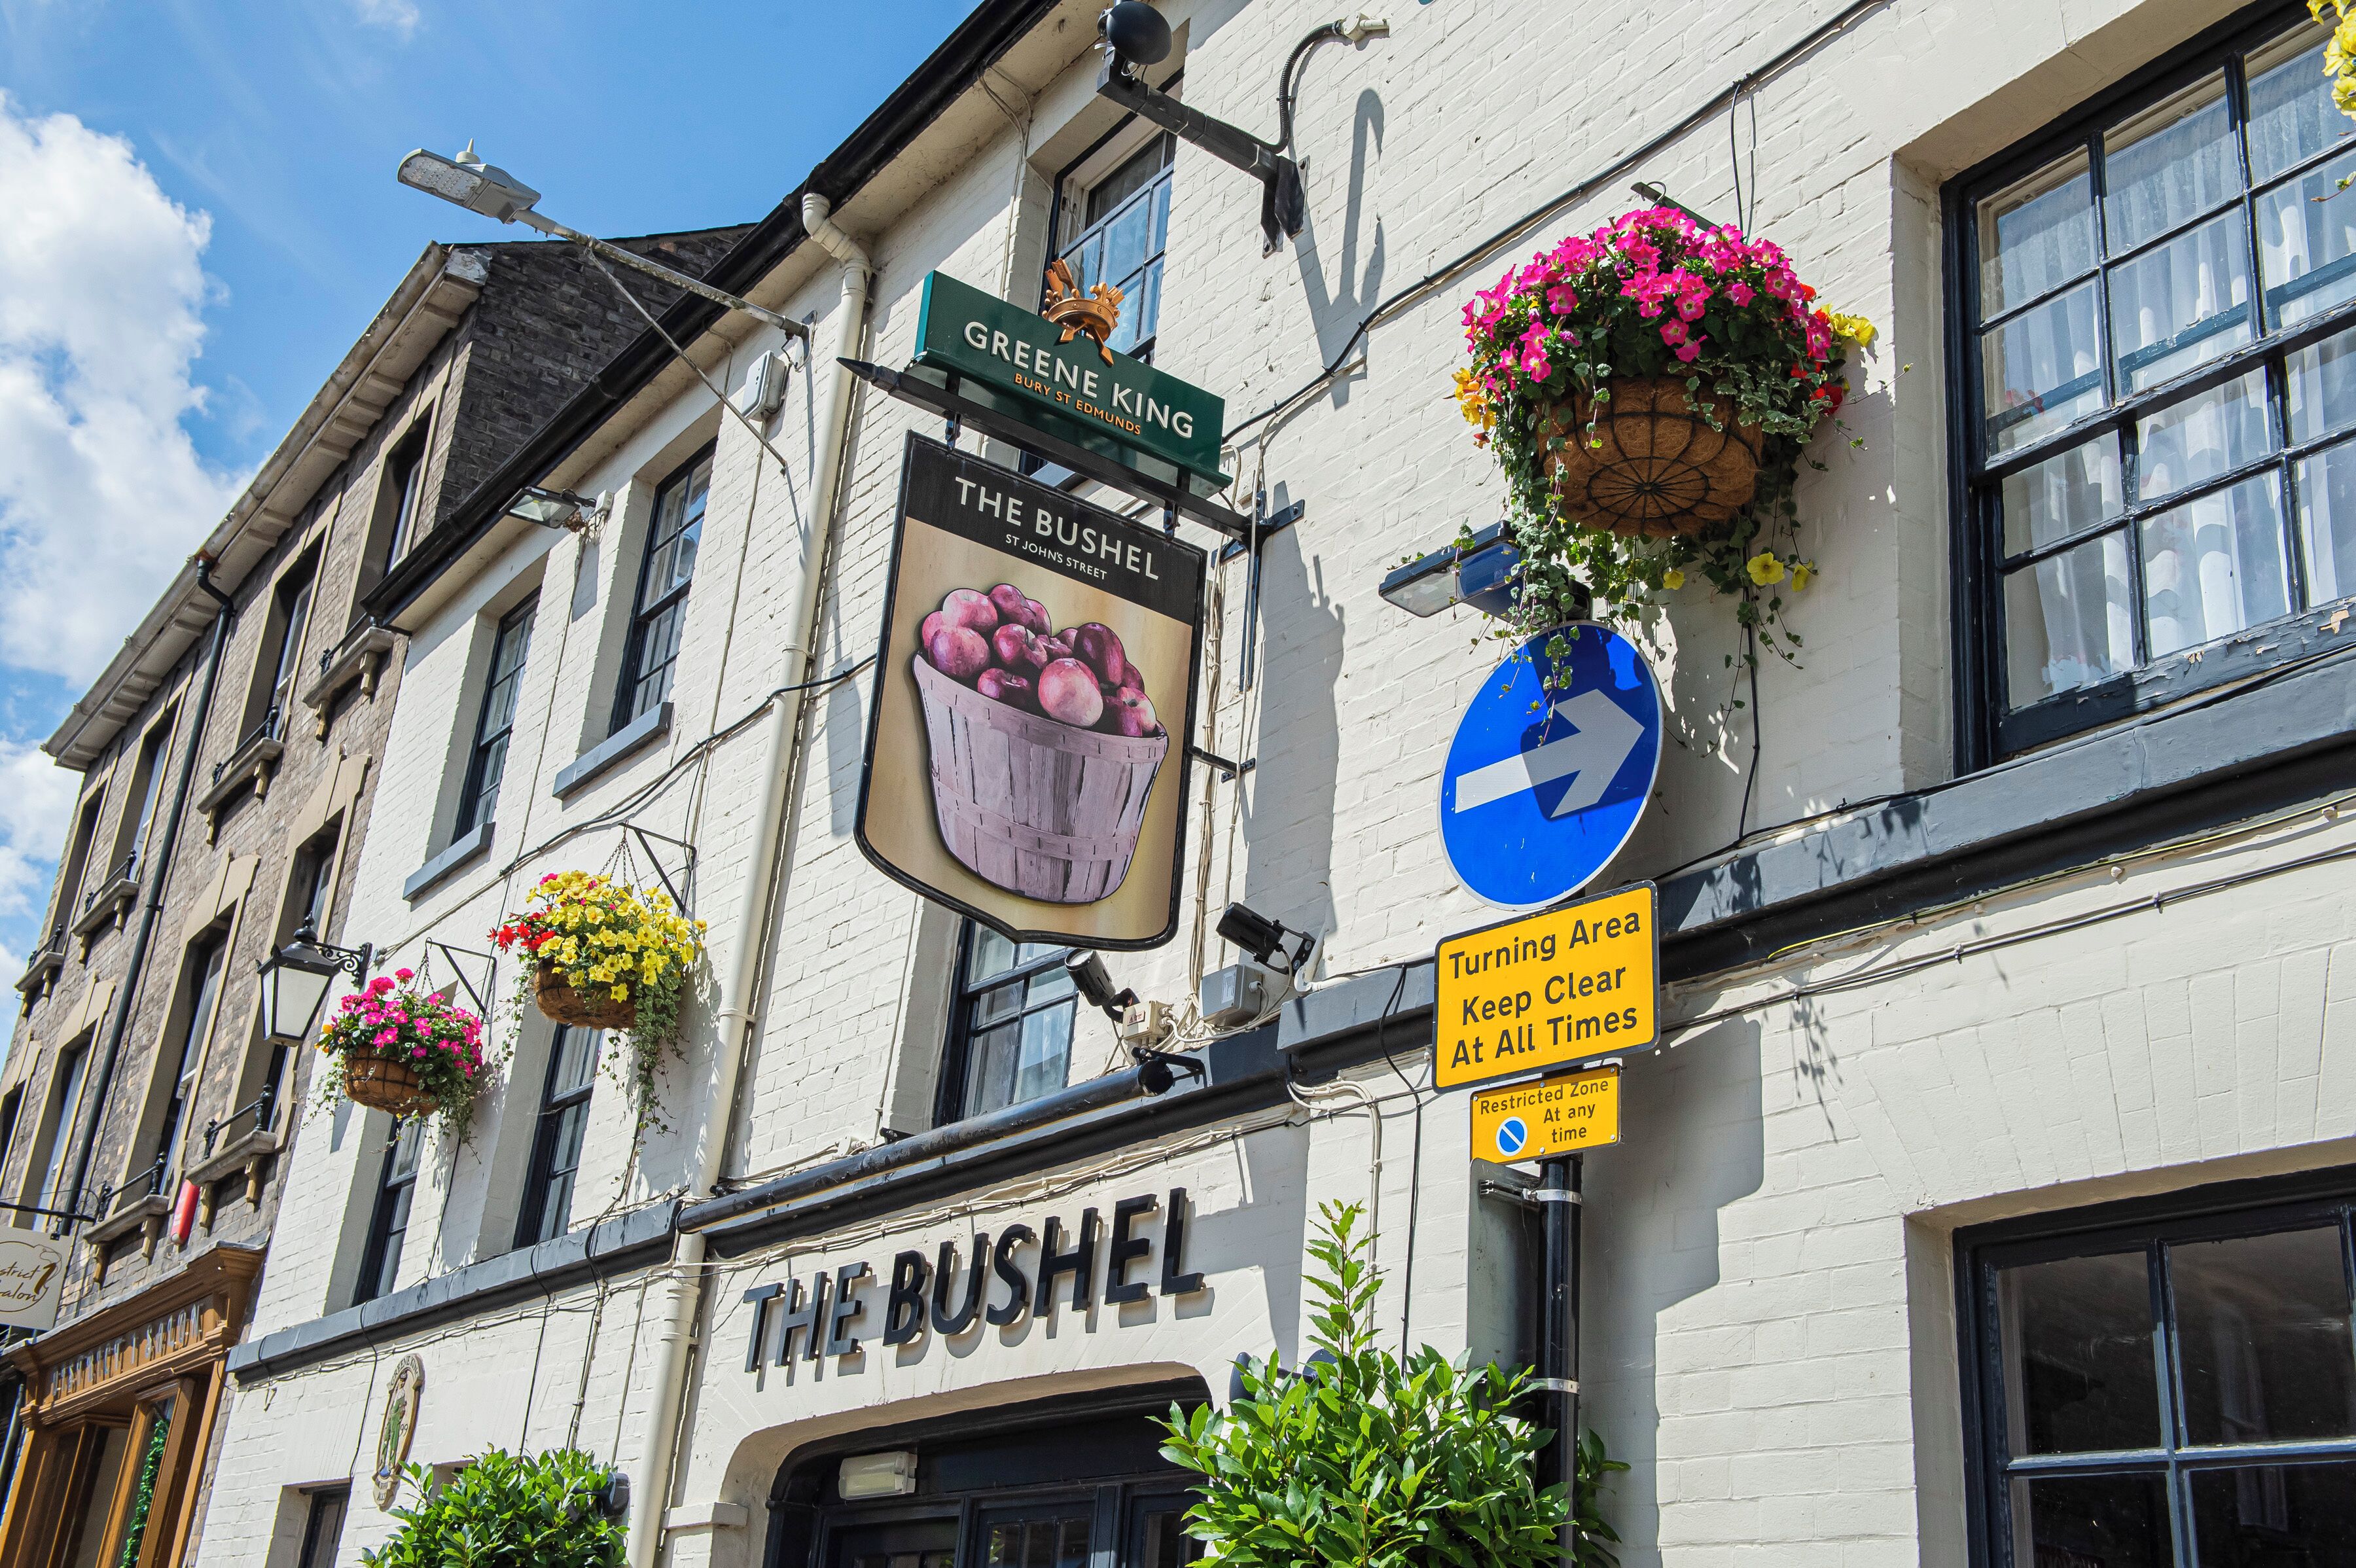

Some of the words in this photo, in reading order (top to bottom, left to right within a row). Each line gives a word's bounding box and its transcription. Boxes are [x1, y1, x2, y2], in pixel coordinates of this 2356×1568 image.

[963, 321, 1099, 400] GREENE
[1112, 382, 1193, 439] KING
[1014, 372, 1051, 396] BURY
[1056, 391, 1070, 404] ST
[1075, 399, 1141, 435] EDMUNDS
[955, 476, 1022, 526] THE
[1035, 509, 1160, 580] BUSHEL
[1005, 533, 1019, 545] ST
[1022, 539, 1063, 565] JOHN'S
[1066, 556, 1107, 580] STREET
[1448, 935, 1556, 979] Turning
[1569, 912, 1641, 950] Area
[1462, 991, 1532, 1026] Keep
[1544, 967, 1626, 1005] Clear
[1450, 1036, 1484, 1069] At
[1495, 1024, 1535, 1059] All
[1546, 1007, 1638, 1046] Times
[1480, 1084, 1563, 1115] Restricted
[1570, 1080, 1609, 1098] Zone
[1543, 1107, 1561, 1124] At
[1567, 1103, 1596, 1119] any
[1552, 1127, 1587, 1144] time
[0, 1282, 41, 1302] alon
[743, 1261, 870, 1374] THE
[882, 1187, 1205, 1347] BUSHEL
